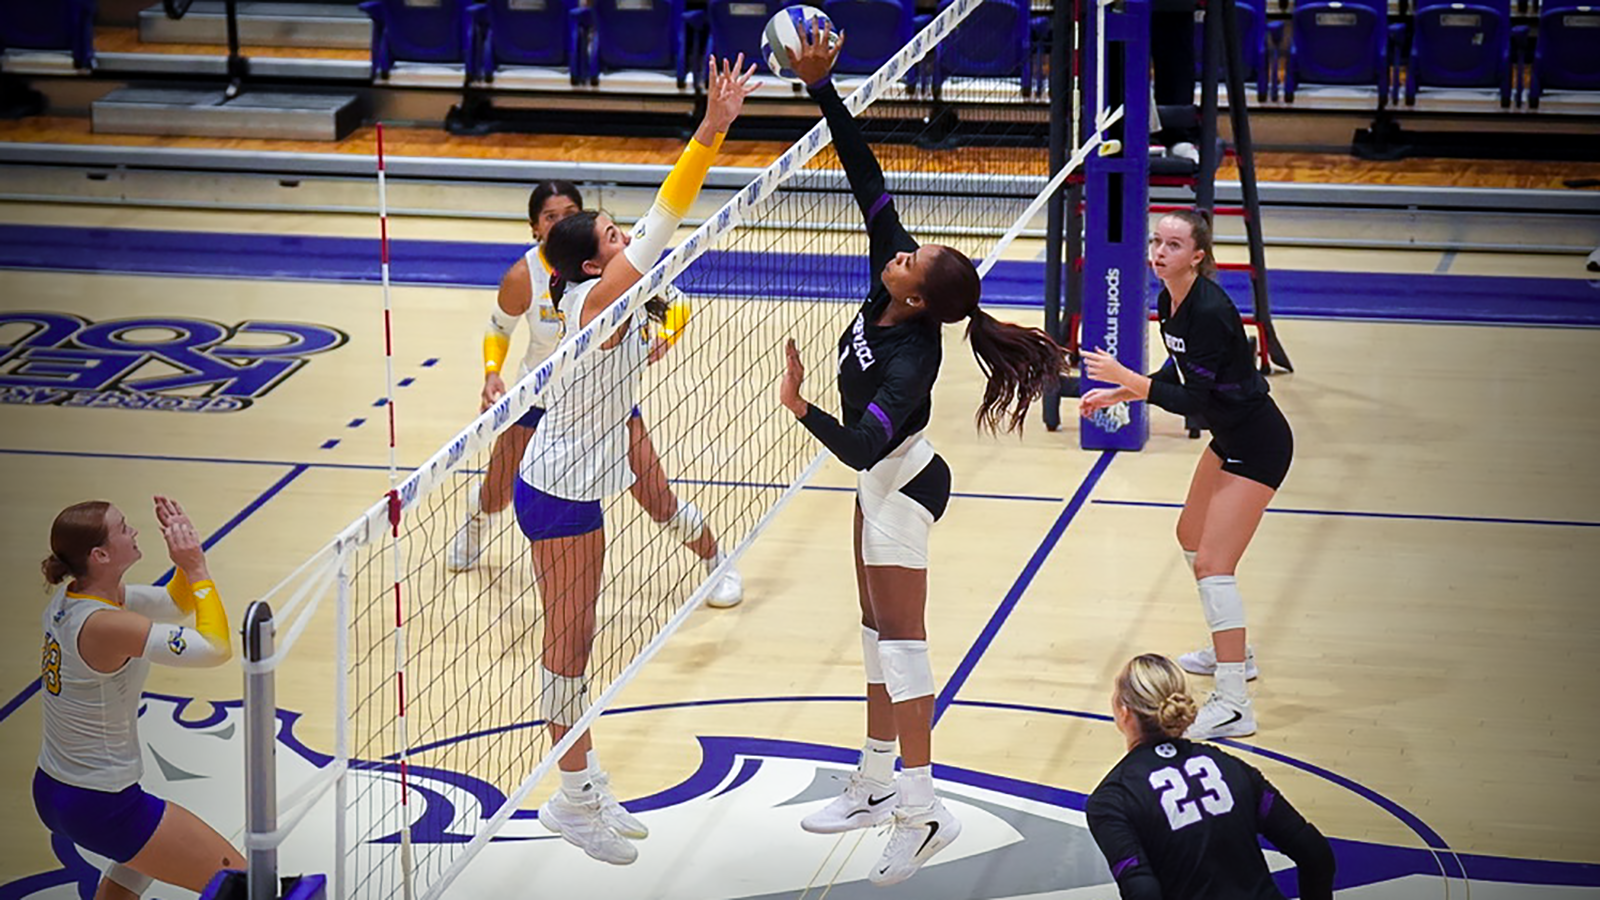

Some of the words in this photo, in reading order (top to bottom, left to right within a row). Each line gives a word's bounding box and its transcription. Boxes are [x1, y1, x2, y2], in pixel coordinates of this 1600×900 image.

[1105, 268, 1121, 316] sports
[1104, 317, 1120, 358] impo
[0, 348, 303, 398] KE
[61, 390, 244, 412] GEORGE
[1149, 755, 1234, 831] 23
